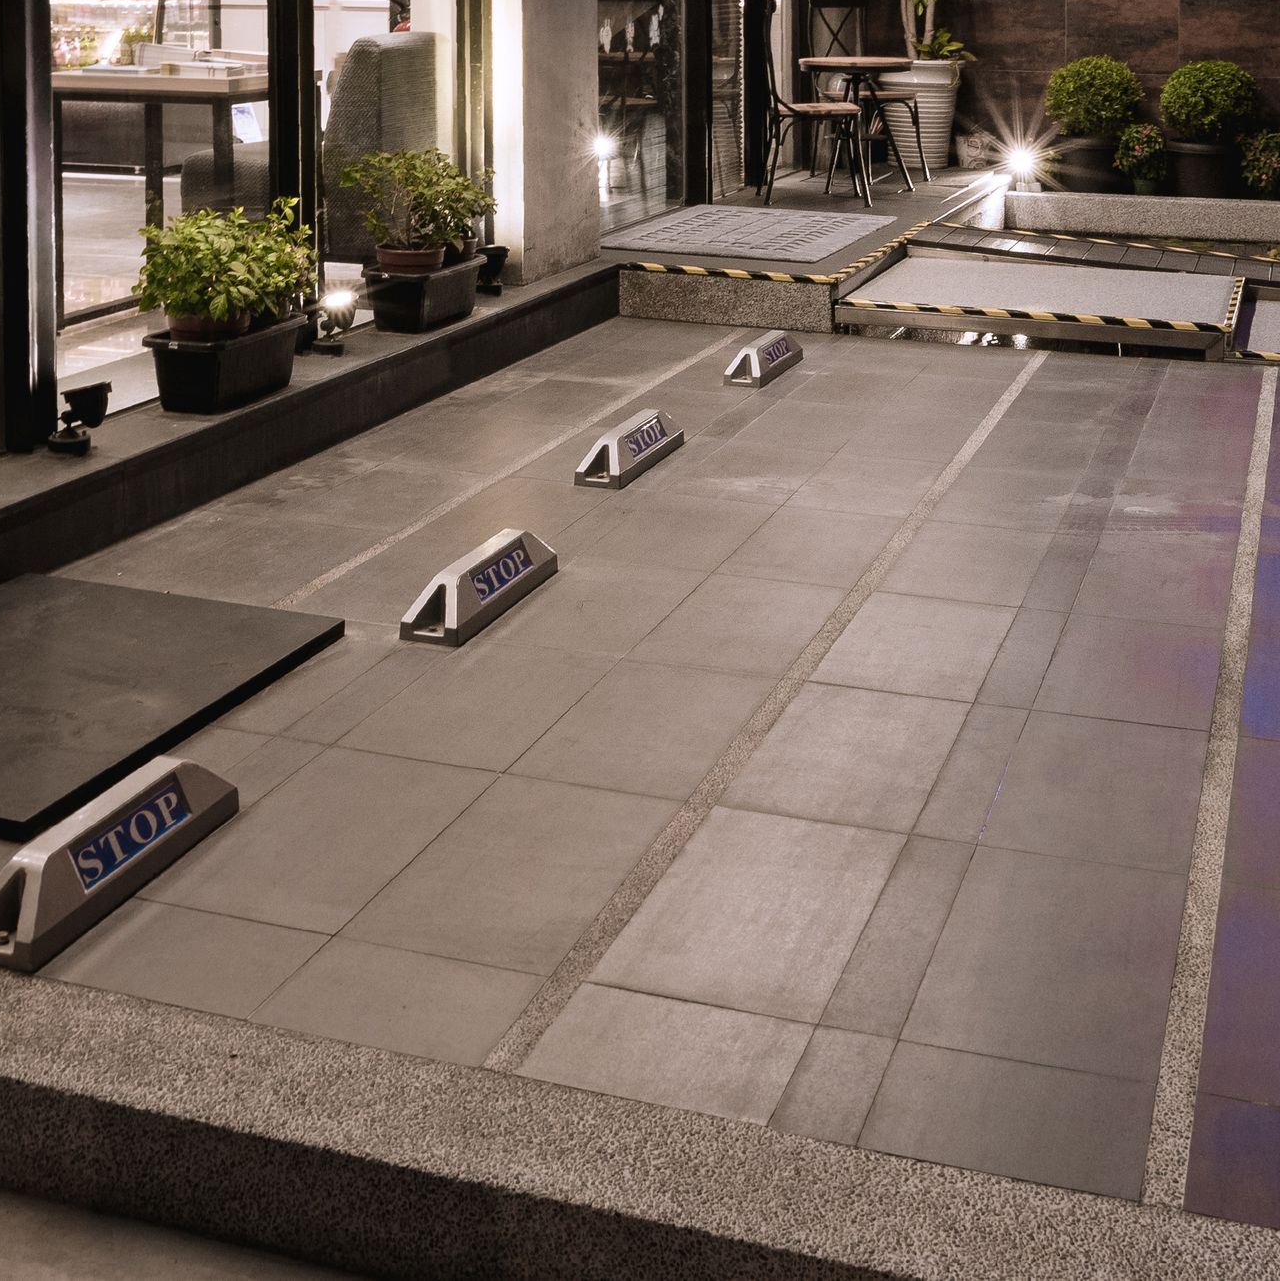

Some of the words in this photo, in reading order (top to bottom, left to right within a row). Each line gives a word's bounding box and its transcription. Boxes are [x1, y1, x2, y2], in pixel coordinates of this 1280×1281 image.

[762, 338, 789, 364] STOP
[627, 422, 663, 456] STOP
[472, 548, 525, 599] STOP
[77, 790, 179, 884] STOP
